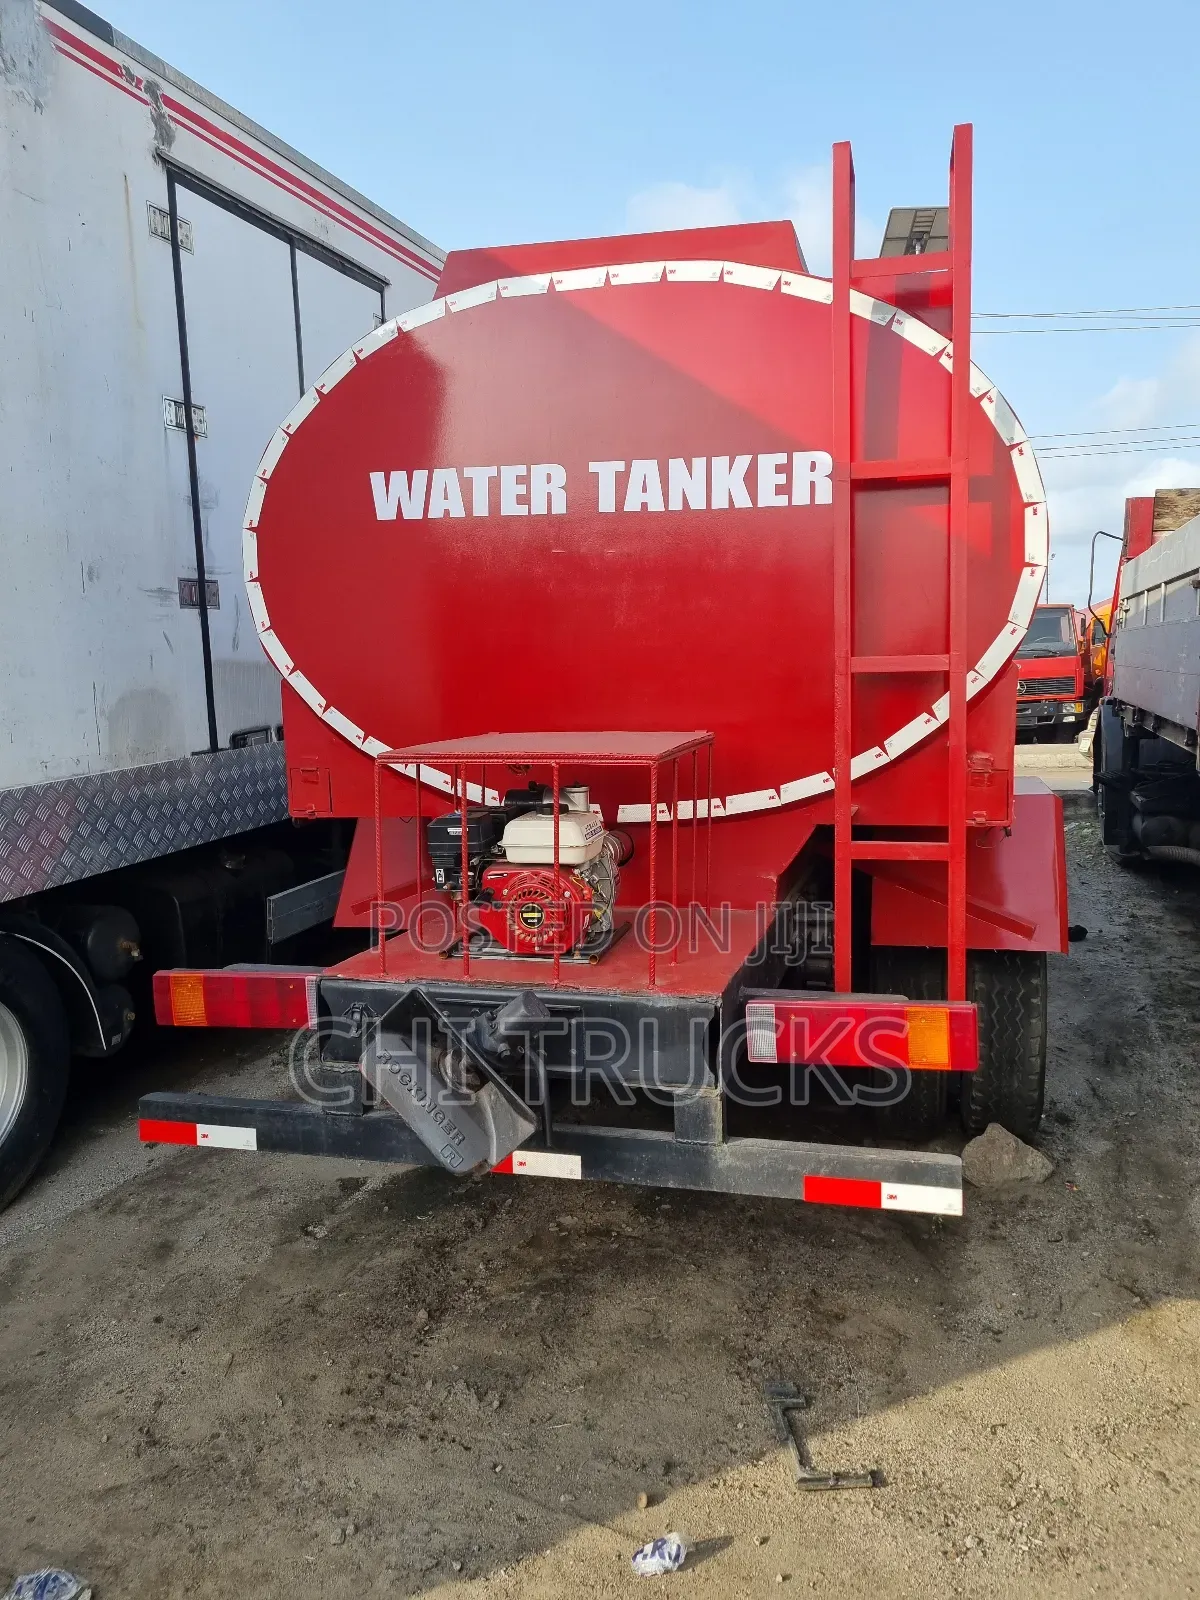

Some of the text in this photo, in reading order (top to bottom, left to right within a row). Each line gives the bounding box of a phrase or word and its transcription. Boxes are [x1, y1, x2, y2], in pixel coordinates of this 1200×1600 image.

[370, 451, 833, 520] WATER TANKER
[377, 1049, 465, 1146] ROCKINGER
